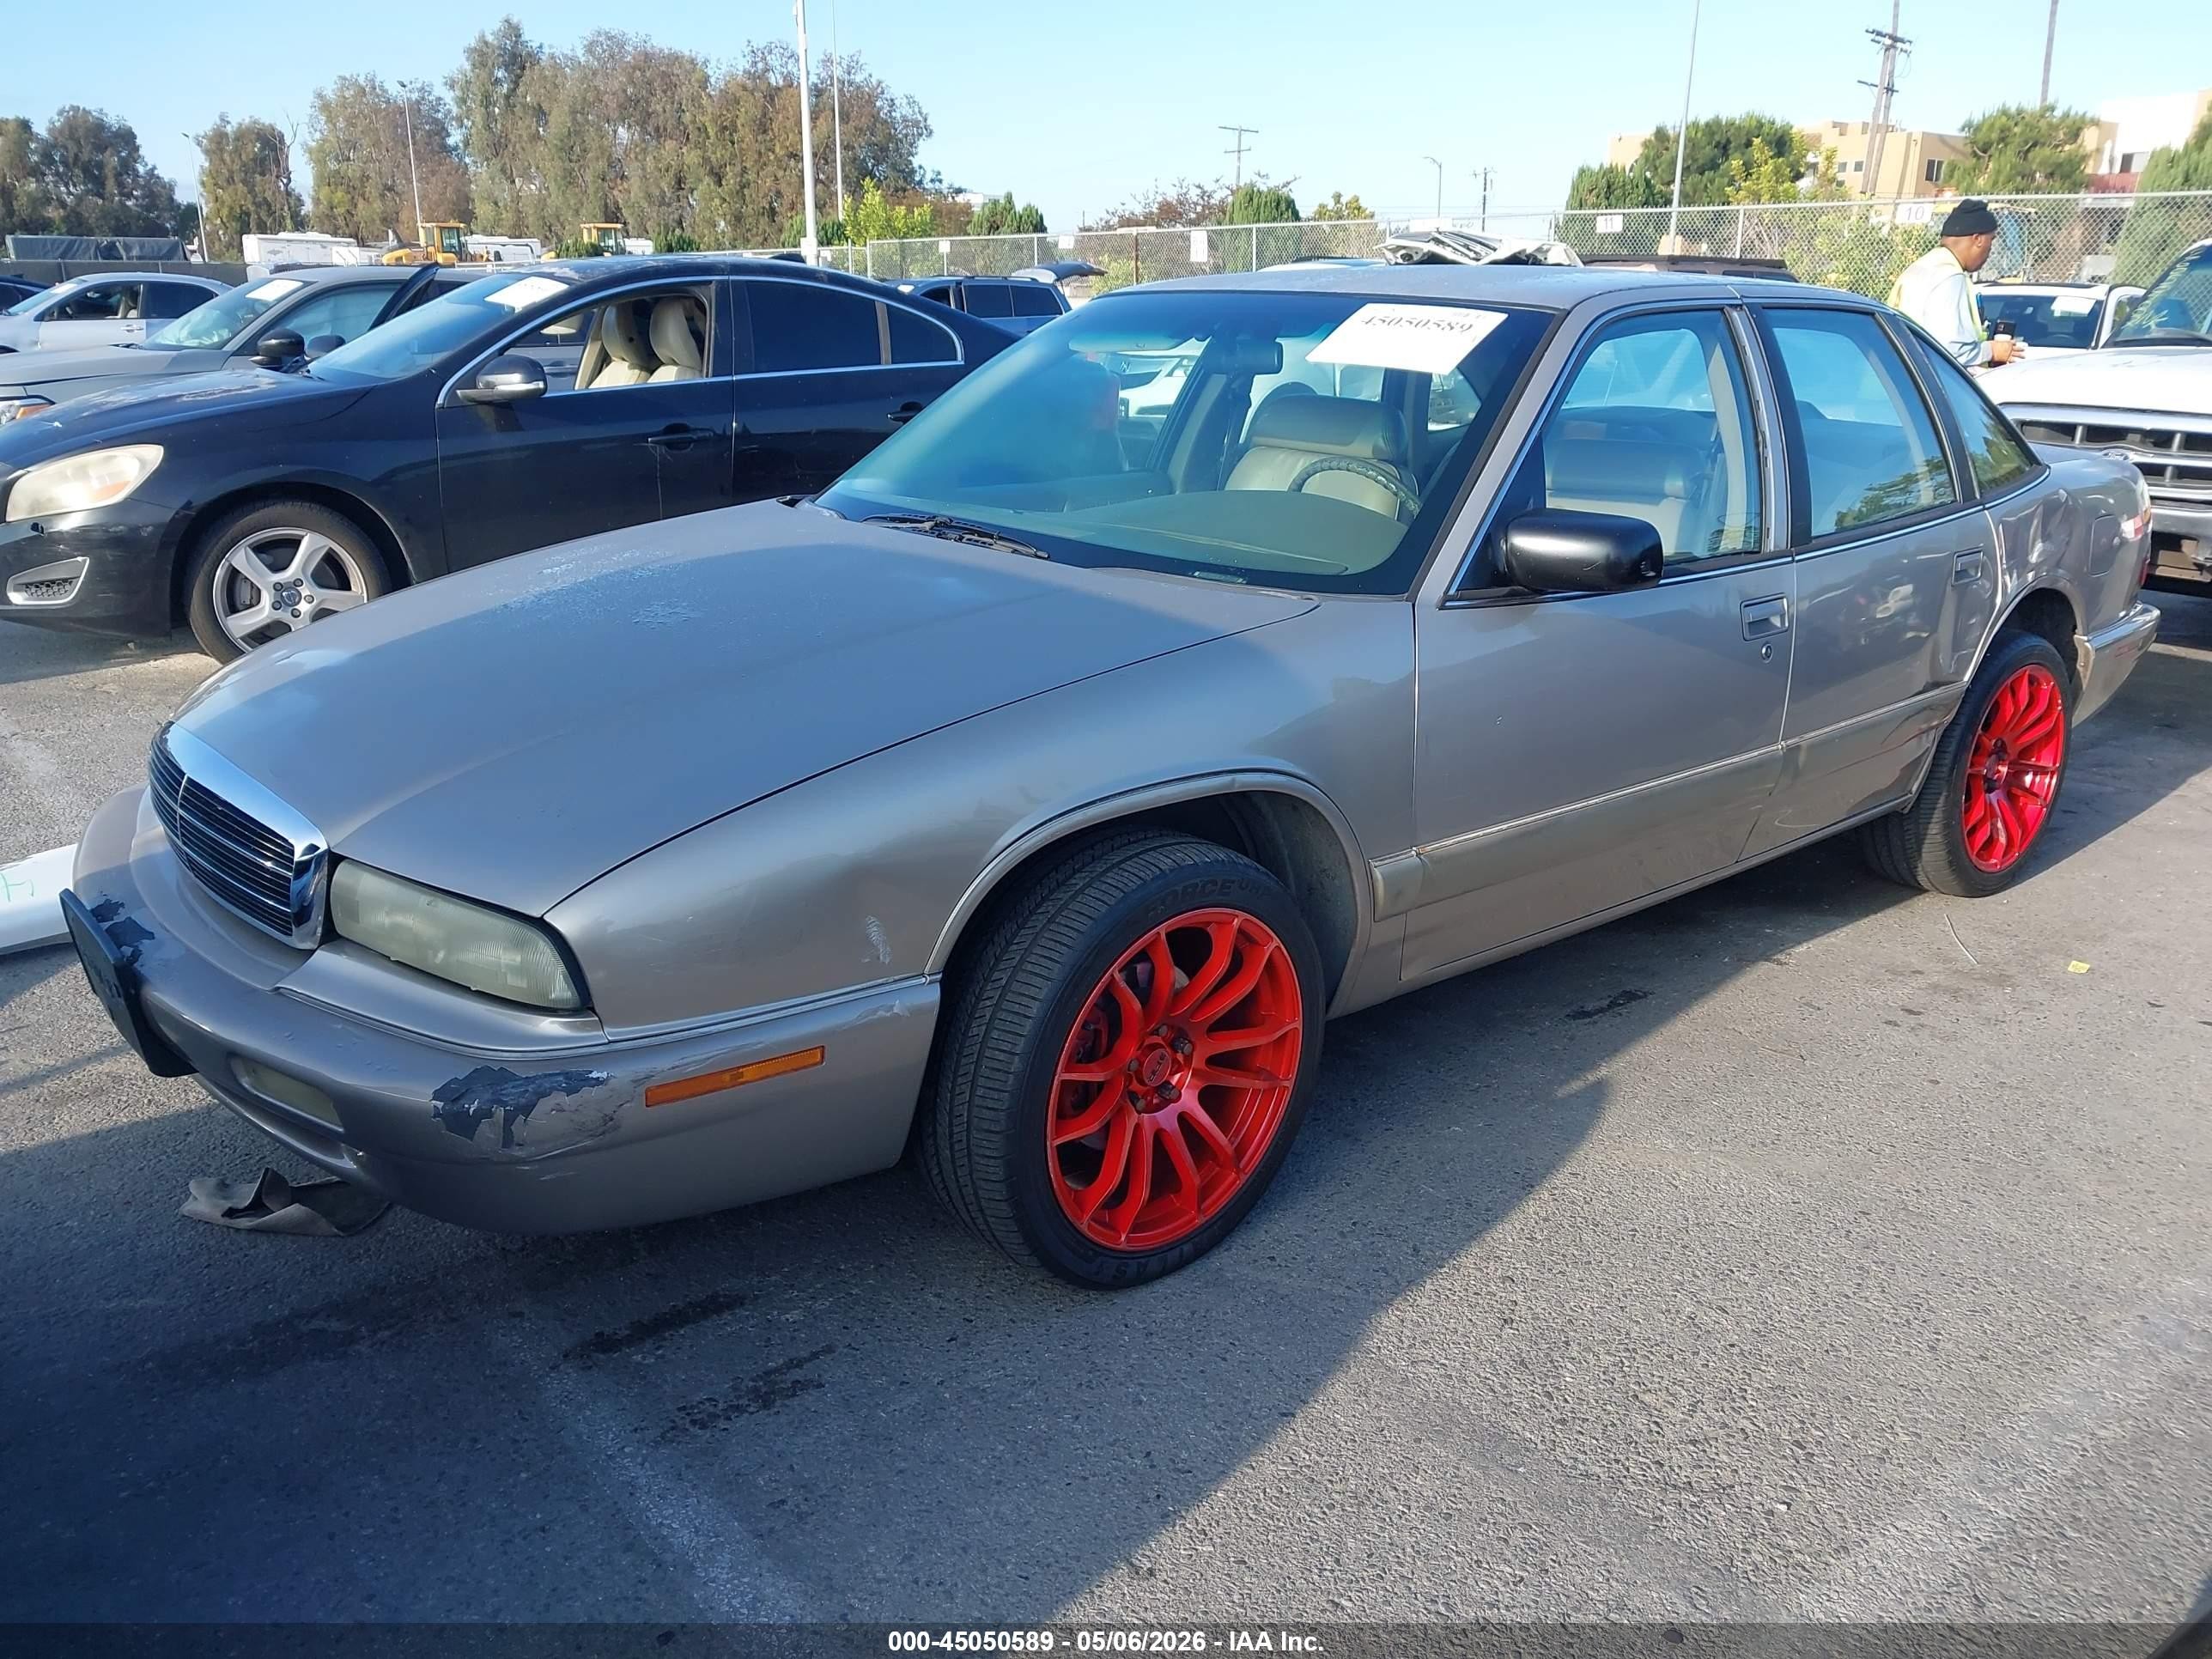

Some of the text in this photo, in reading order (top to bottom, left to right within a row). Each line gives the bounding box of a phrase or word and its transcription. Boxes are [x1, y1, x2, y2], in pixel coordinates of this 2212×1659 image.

[1905, 205, 1924, 221] 10
[1603, 216, 1613, 230] 11
[1360, 315, 1474, 333] 45050589
